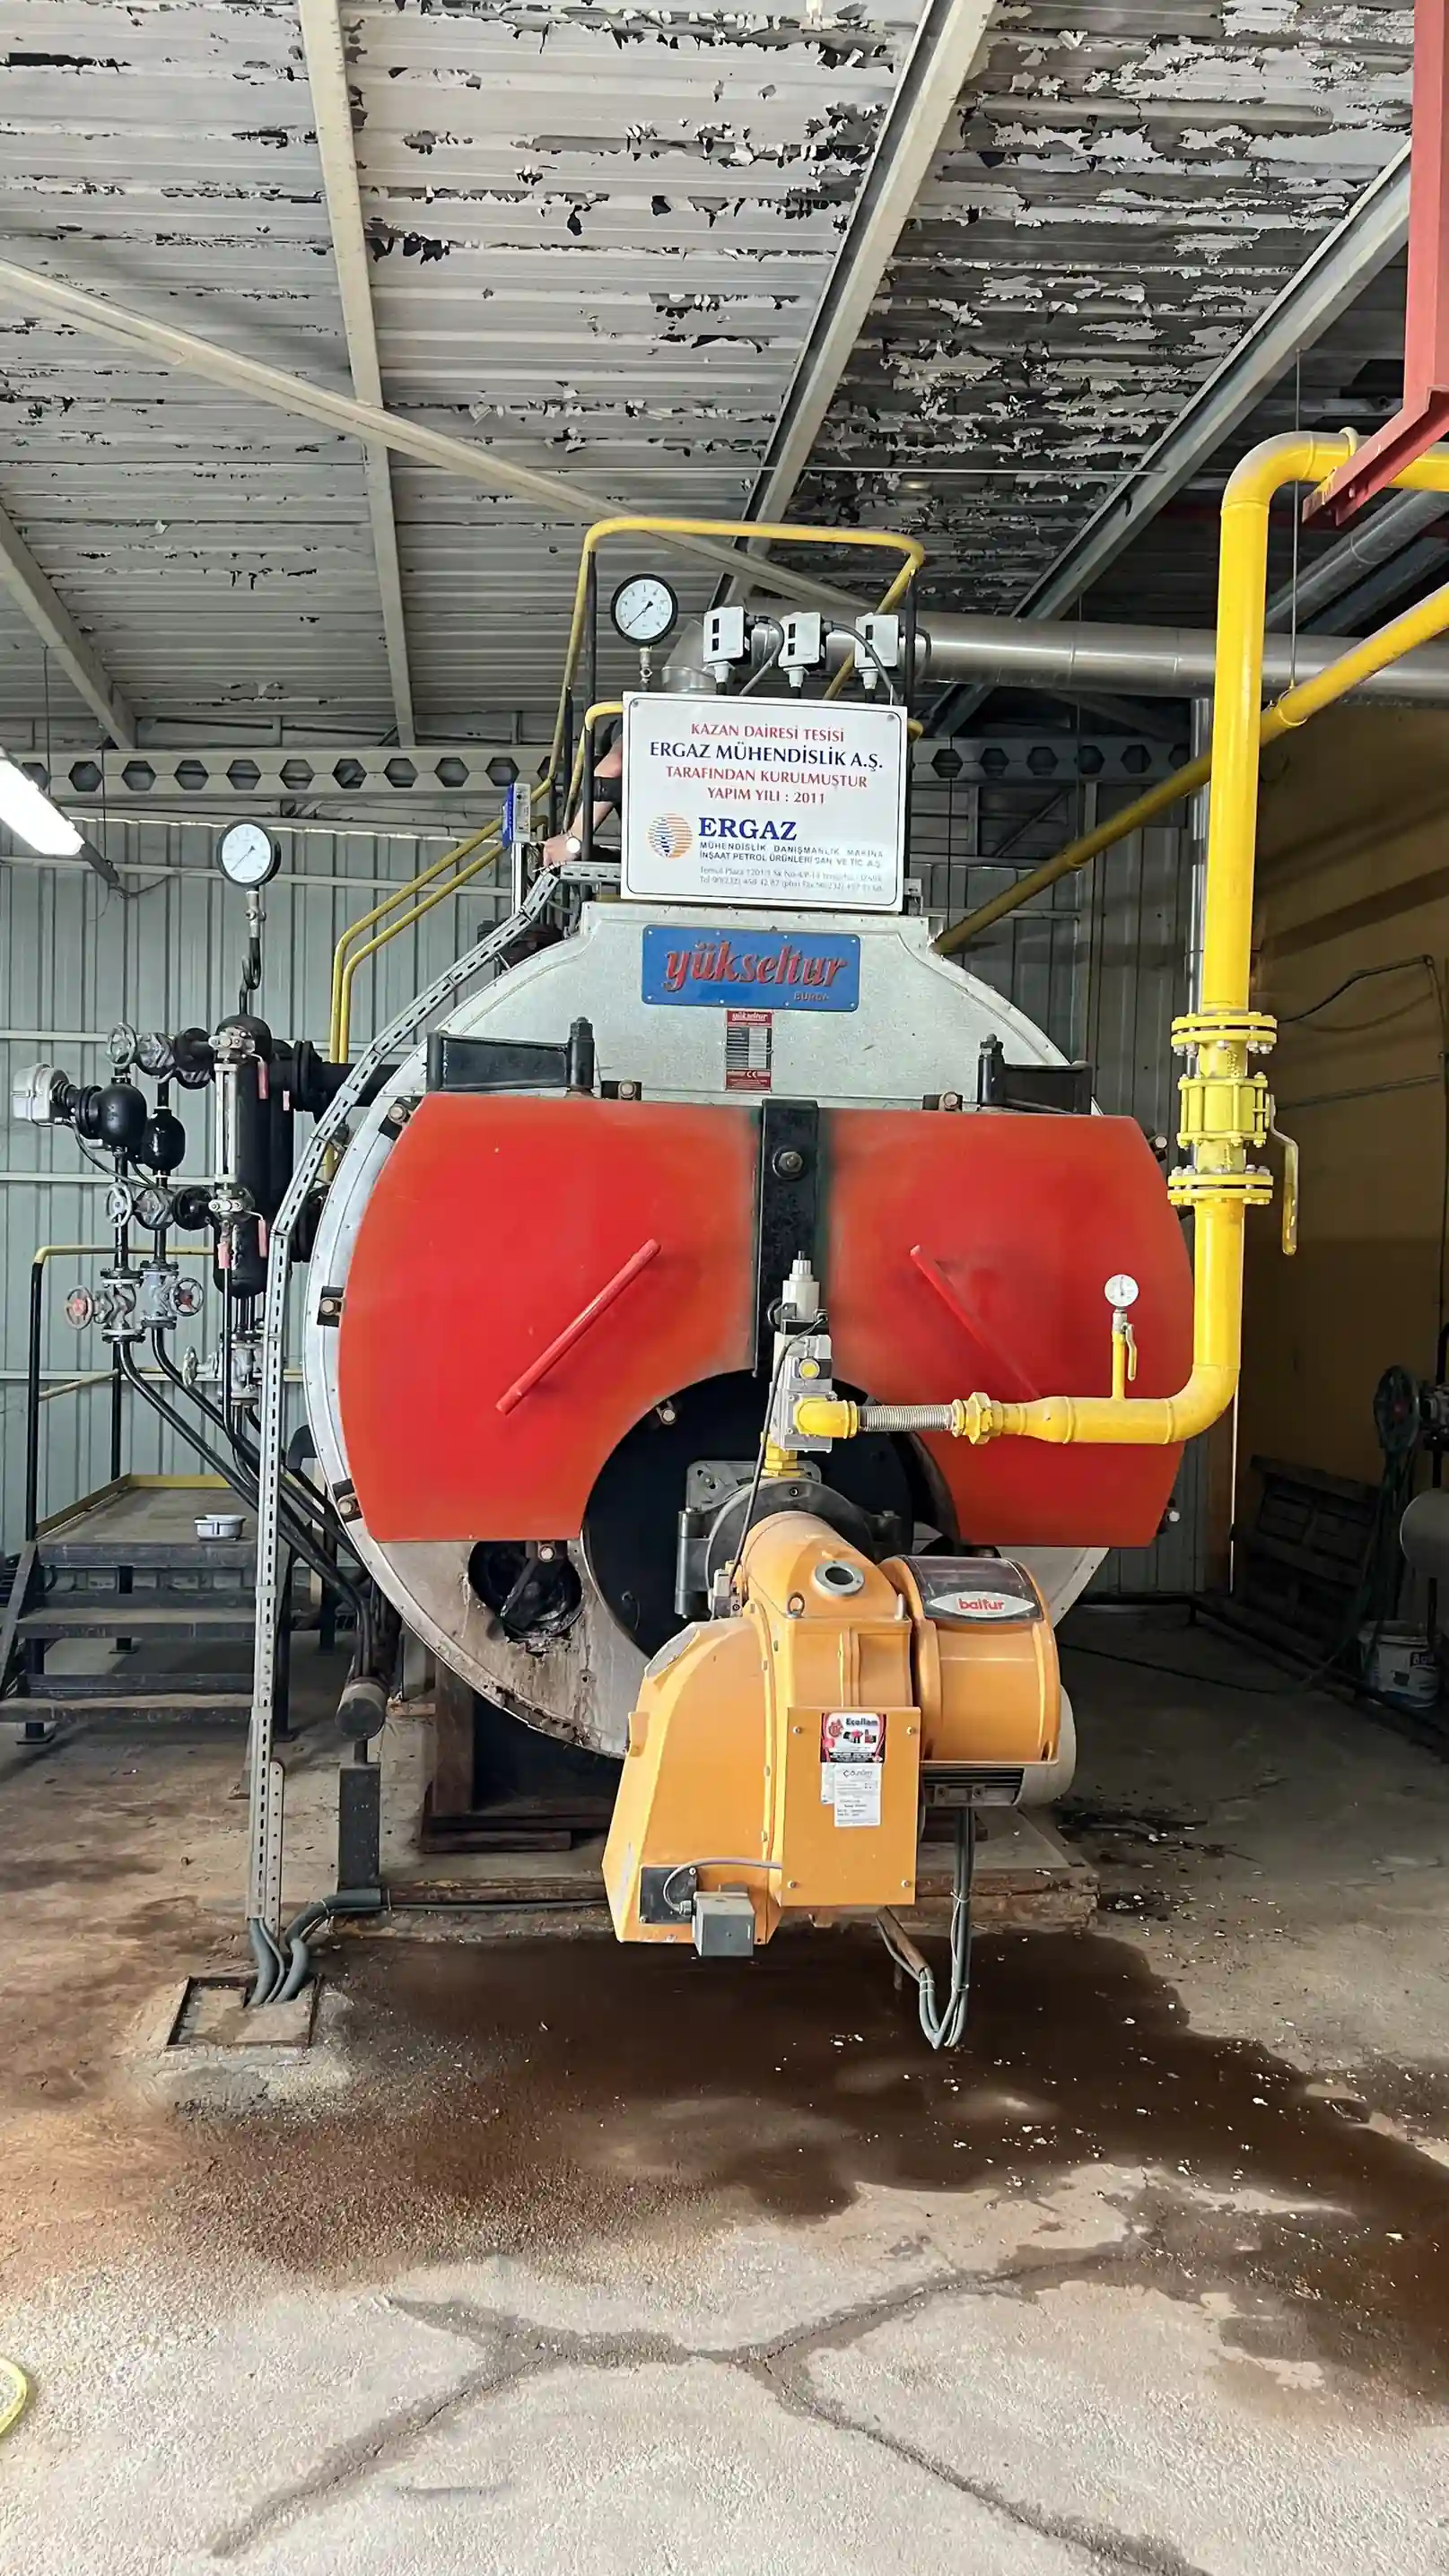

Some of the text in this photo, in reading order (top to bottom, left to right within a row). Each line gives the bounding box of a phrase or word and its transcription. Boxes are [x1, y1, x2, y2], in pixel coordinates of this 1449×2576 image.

[691, 723, 844, 742] KAZAN DAİRESİ TESİSİ
[650, 741, 883, 772] ERGAZ MÜHENDİSLİK A.Ş.
[666, 766, 755, 781] TARAFINDAN
[707, 787, 751, 800] YAPIM
[755, 789, 780, 802] YILI
[794, 792, 825, 804] 2011
[698, 817, 798, 841] ERGAZ
[700, 841, 766, 852] MÜHENDİSLİK
[700, 850, 730, 860] İNŞAAT
[733, 853, 766, 862] PETROL
[664, 940, 848, 993] yükseltur
[958, 1597, 1005, 1611] baltur
[845, 1718, 878, 1727] Ecoflam
